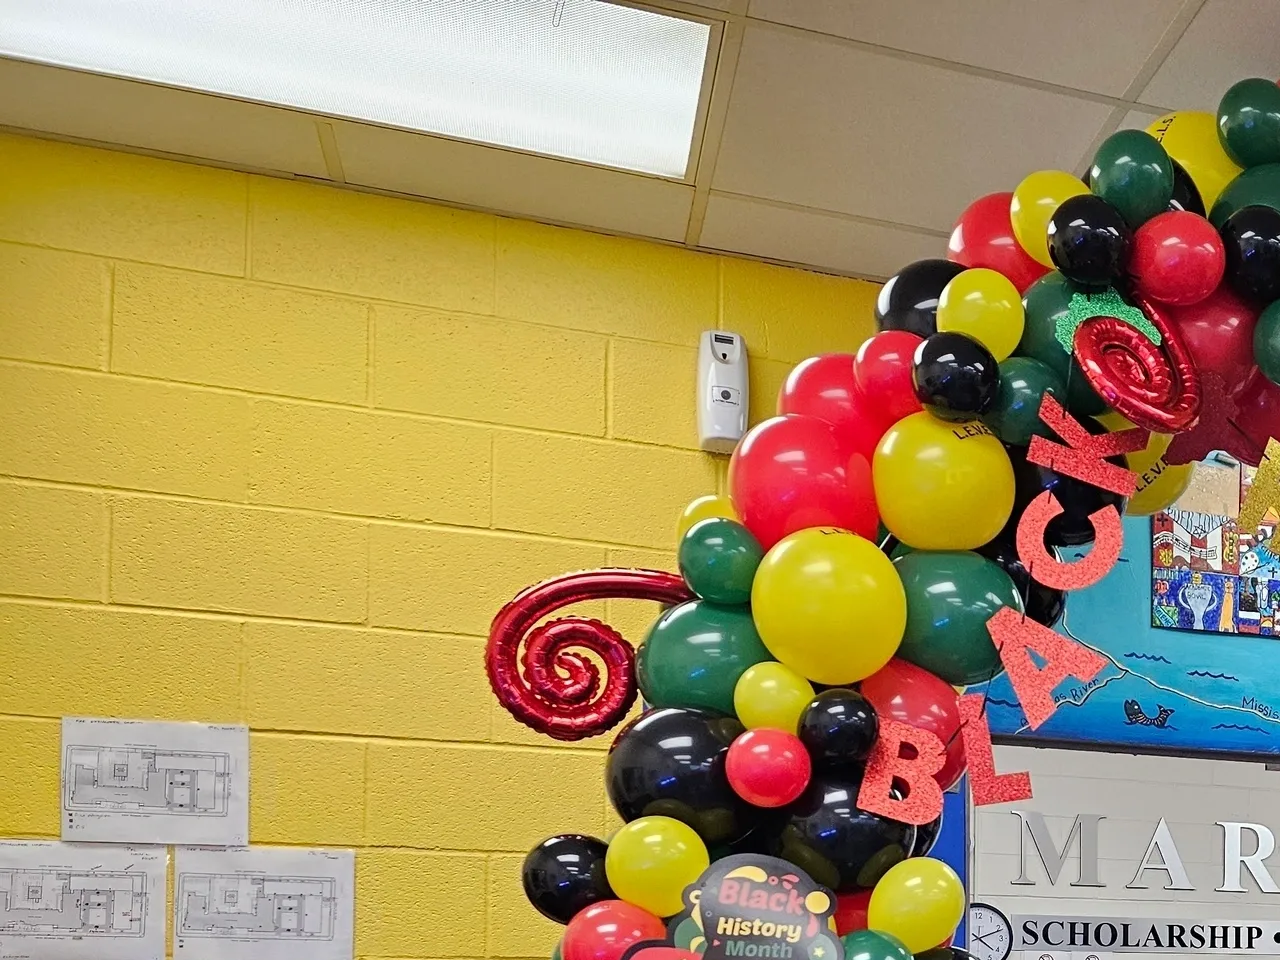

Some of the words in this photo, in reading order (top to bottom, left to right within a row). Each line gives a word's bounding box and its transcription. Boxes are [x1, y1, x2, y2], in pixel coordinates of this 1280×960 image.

[1069, 677, 1099, 701] River
[718, 878, 805, 915] Black
[974, 912, 983, 920] 12
[716, 916, 802, 943] History
[998, 934, 1004, 942] 3
[1021, 919, 1263, 951] SCHOLARSHIP
[725, 940, 793, 959] Month
